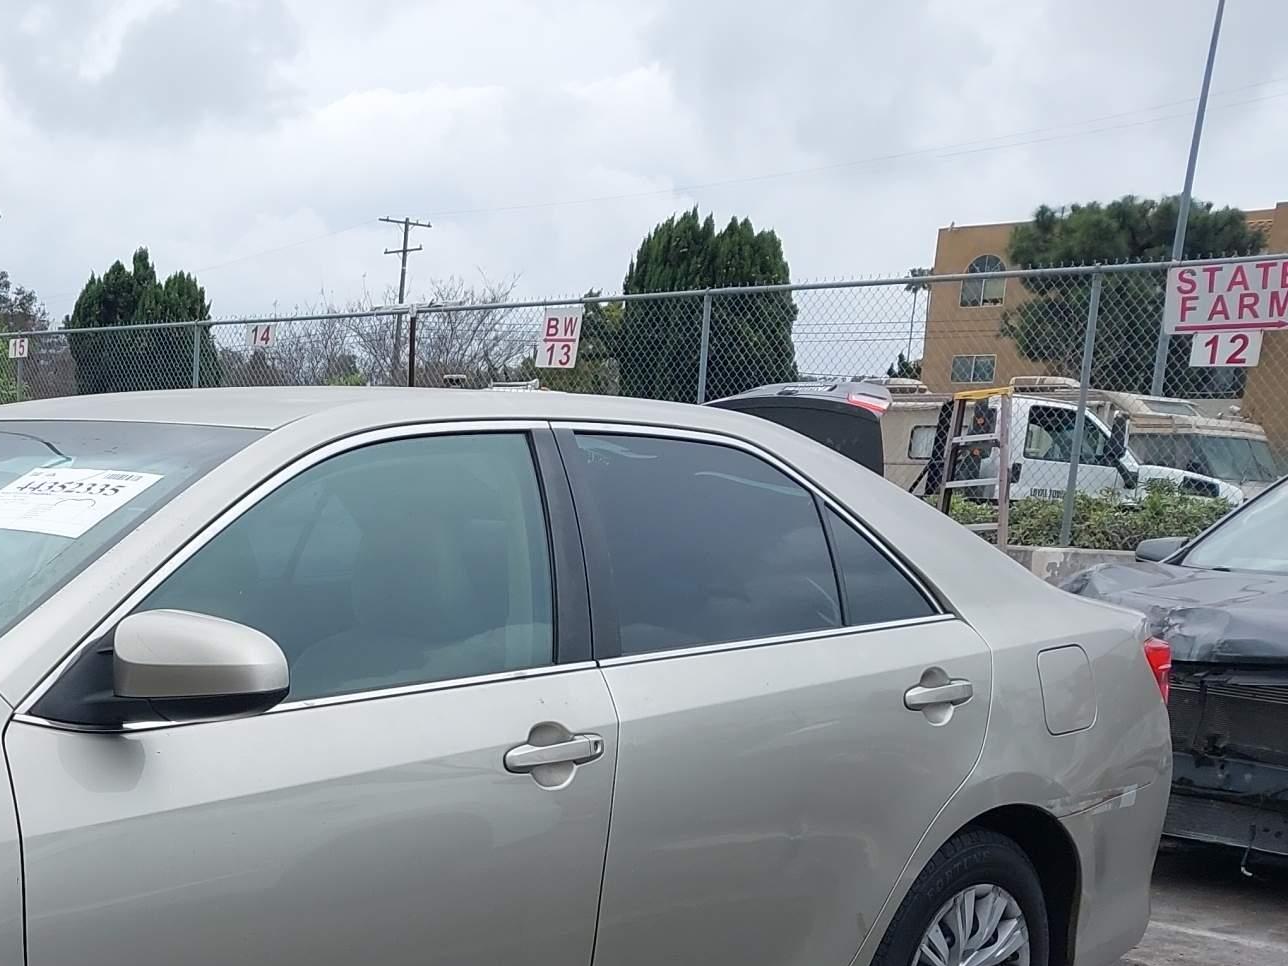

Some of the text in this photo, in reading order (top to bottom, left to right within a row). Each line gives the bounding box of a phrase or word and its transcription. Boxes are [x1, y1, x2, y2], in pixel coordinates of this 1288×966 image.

[1180, 291, 1288, 322] FARM
[251, 324, 270, 345] 14
[546, 316, 578, 337] BW
[12, 339, 25, 356] 15
[546, 343, 571, 366] 13
[1204, 333, 1249, 365] 12
[16, 481, 127, 497] 44352335
